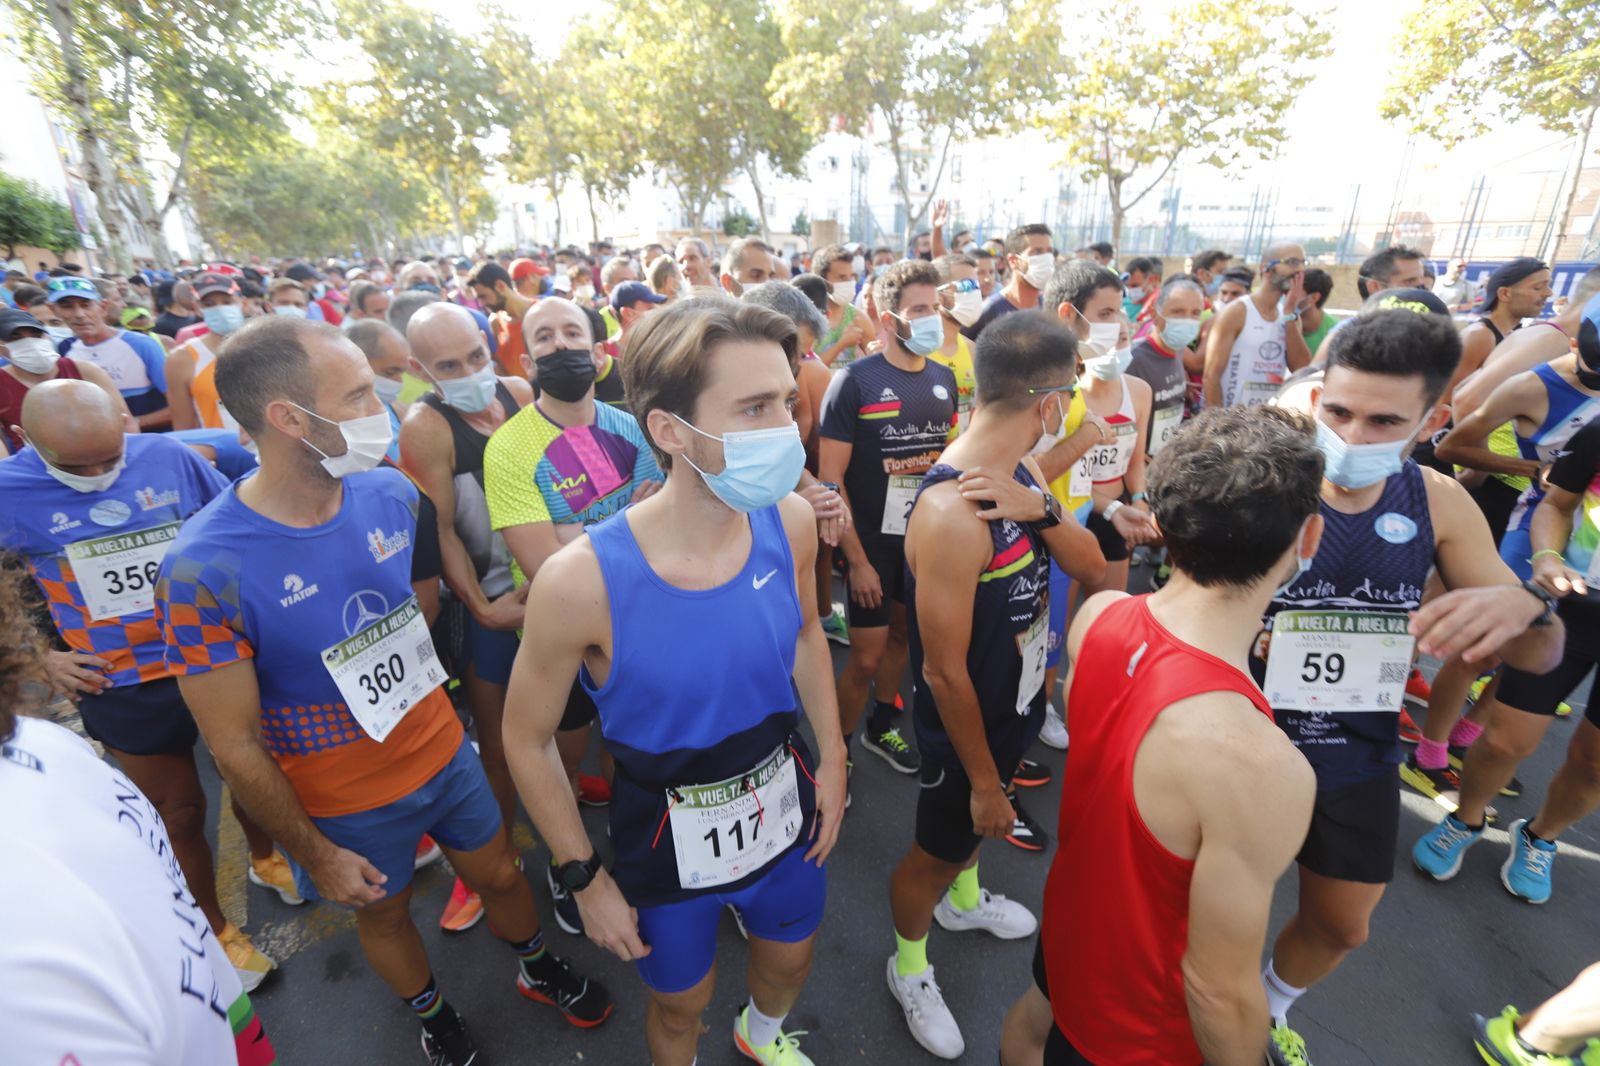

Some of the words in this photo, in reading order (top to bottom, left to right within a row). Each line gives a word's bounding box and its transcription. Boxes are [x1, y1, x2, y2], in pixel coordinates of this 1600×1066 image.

[1253, 361, 1283, 369] TOYOTA
[92, 538, 135, 555] VUELTA
[136, 536, 145, 547] A
[103, 562, 158, 595] 356
[280, 584, 319, 608] VIATOR
[345, 629, 380, 656] VUELTA
[381, 622, 389, 636] A
[389, 606, 416, 631] HUELVA
[1298, 615, 1341, 631] VUELTA
[1344, 617, 1354, 631] A
[1358, 617, 1405, 632] HUELVA
[359, 653, 405, 705] 360
[1301, 653, 1345, 684] 59
[759, 749, 786, 785] HUELVA
[704, 808, 764, 858] 117
